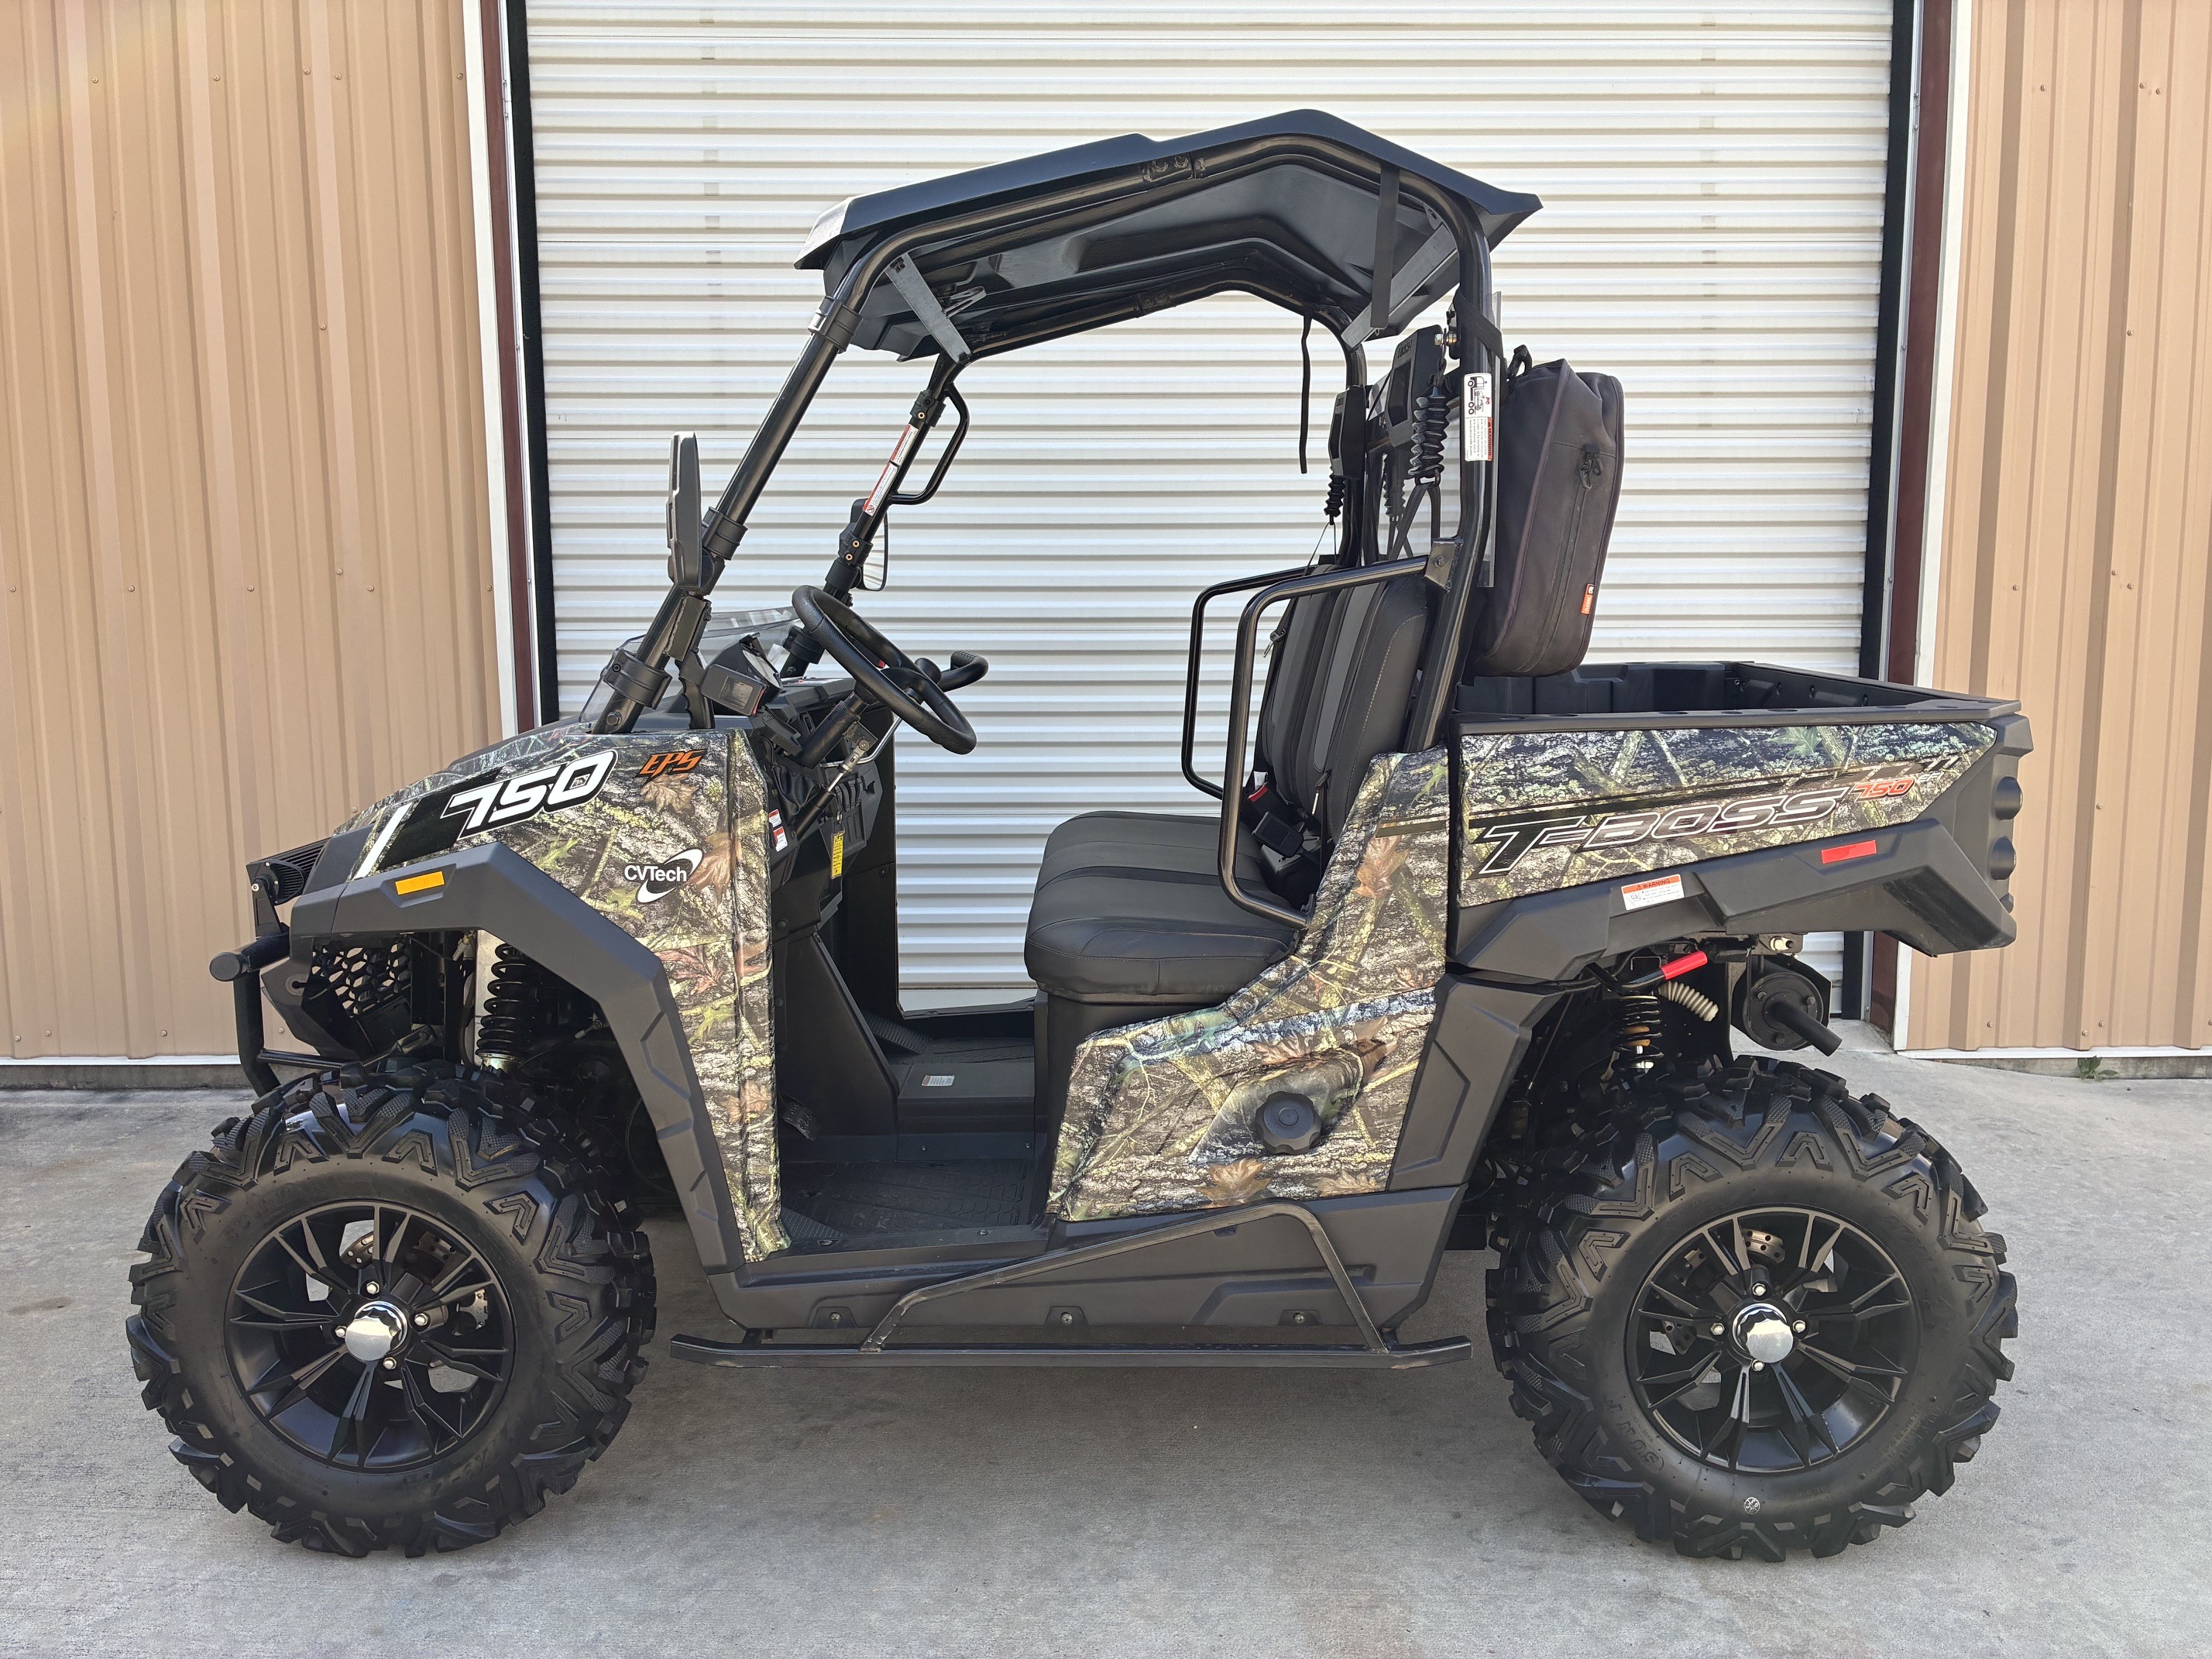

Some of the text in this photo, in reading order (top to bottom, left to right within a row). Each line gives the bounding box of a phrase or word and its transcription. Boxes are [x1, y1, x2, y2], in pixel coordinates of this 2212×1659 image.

[639, 750, 705, 778] EPS
[443, 750, 617, 836] 750
[1479, 787, 1847, 874] T-BOSS
[1850, 777, 1915, 802] 750
[623, 864, 688, 882] CVTech
[1642, 878, 1671, 889] WARNING
